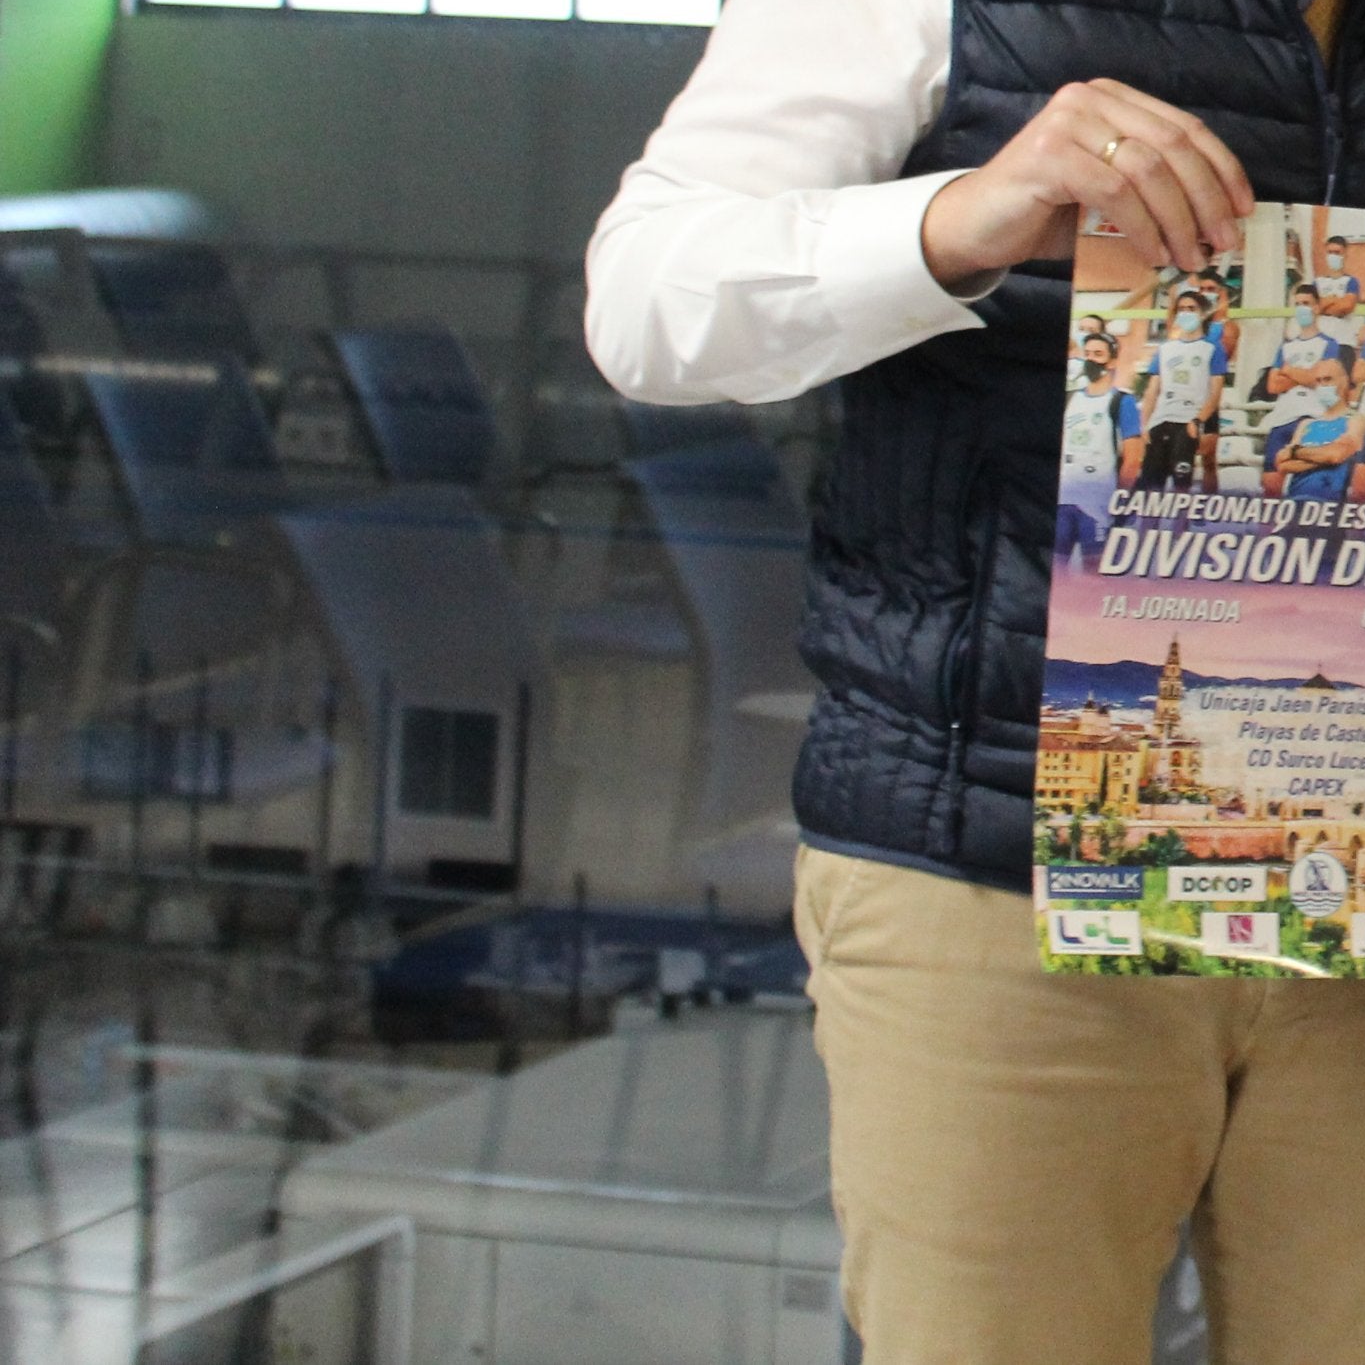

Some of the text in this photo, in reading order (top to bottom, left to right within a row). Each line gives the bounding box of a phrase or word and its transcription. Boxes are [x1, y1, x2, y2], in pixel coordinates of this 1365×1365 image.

[1108, 489, 1296, 524] CAMPEONATO
[1299, 501, 1339, 527] DE
[1098, 523, 1327, 585] DIVISIÓN
[1102, 595, 1241, 622] 1A JORNADA
[1200, 692, 1266, 715] Unicaja
[1270, 695, 1313, 713] Jaen
[1238, 721, 1295, 743] Playas
[1299, 724, 1320, 741] de
[1247, 749, 1273, 767] CD
[1276, 750, 1325, 768] Surco
[1288, 777, 1348, 796] CAPEX
